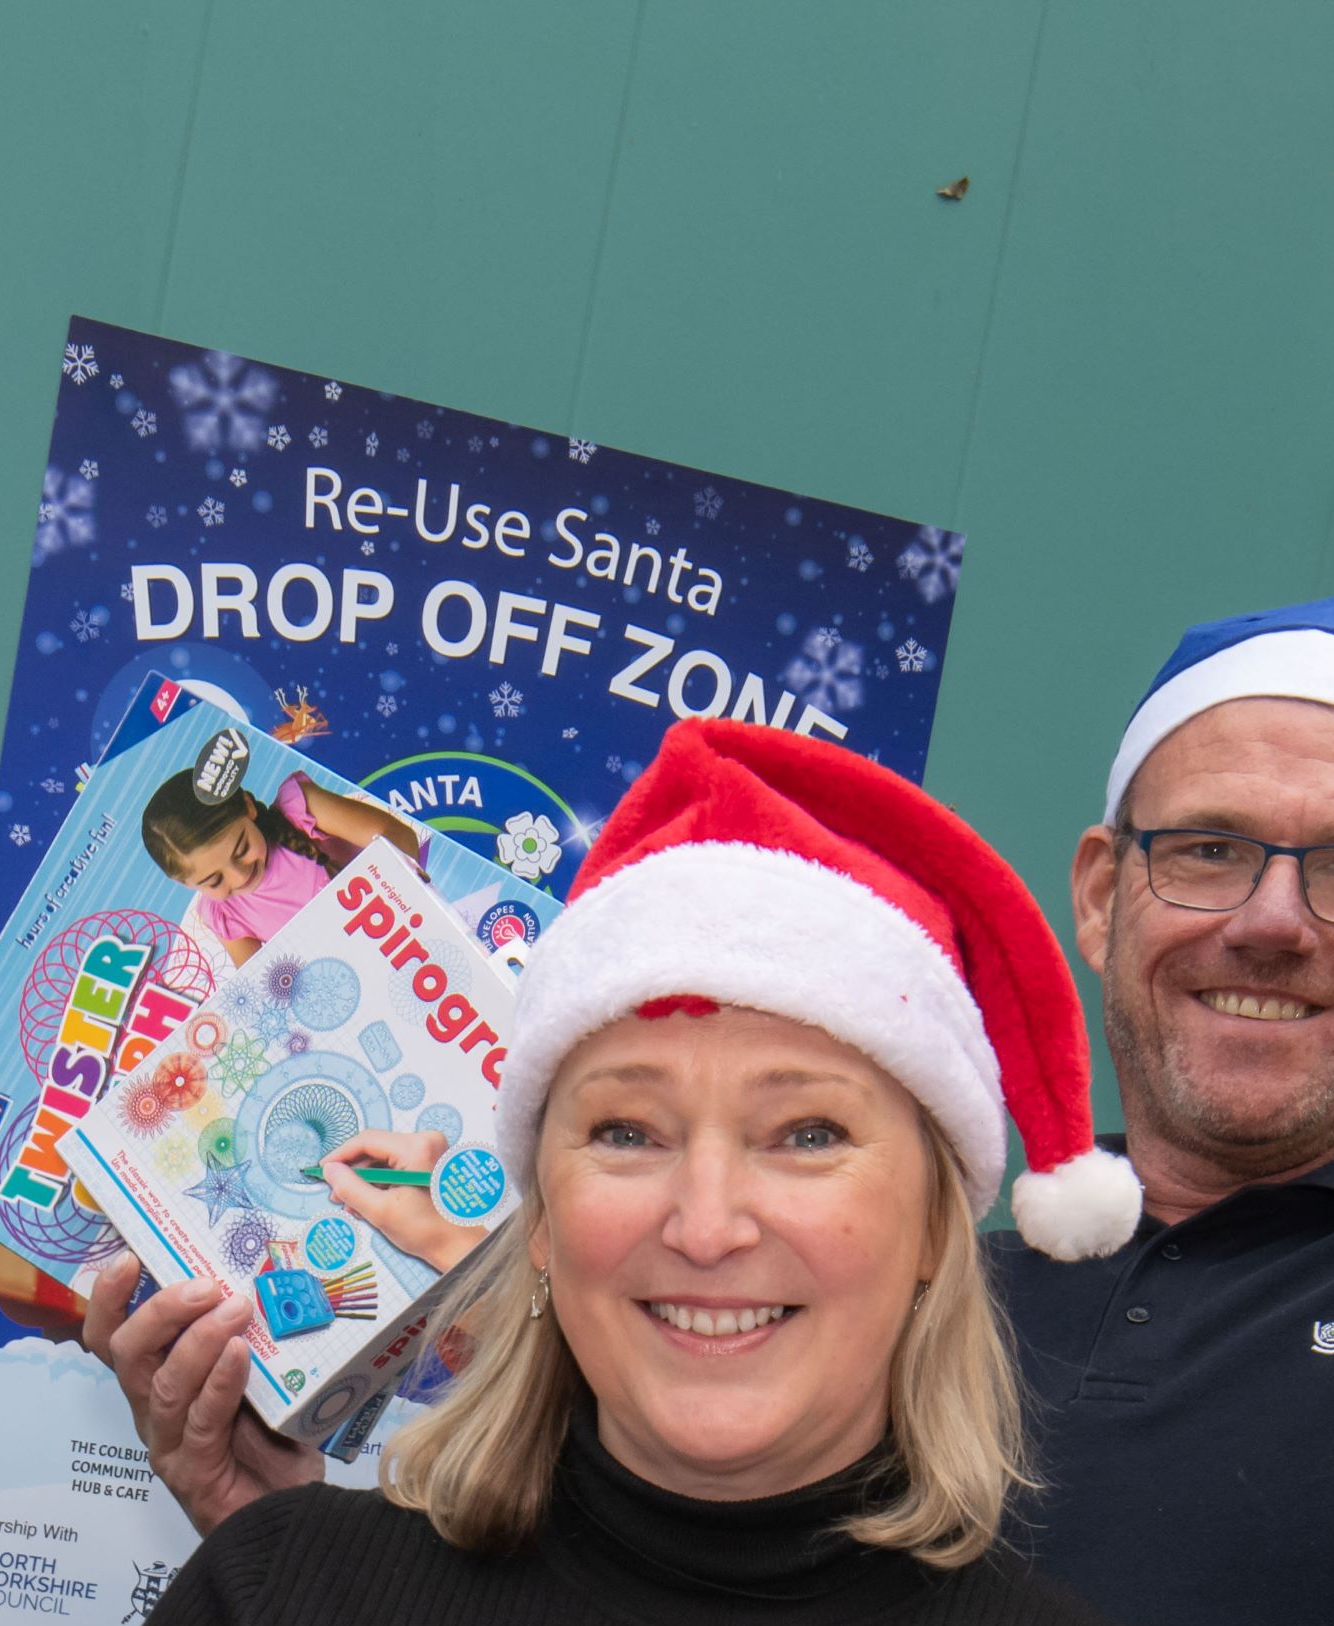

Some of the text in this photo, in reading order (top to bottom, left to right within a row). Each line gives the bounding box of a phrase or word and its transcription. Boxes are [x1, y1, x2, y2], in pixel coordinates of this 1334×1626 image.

[304, 467, 726, 616] Re-Use Santa
[131, 562, 395, 643] DROP
[421, 579, 601, 677] OFF
[157, 691, 169, 711] 4+
[197, 736, 234, 792] NEW!
[389, 775, 483, 813] ANTA
[16, 812, 117, 949] hours of creative fun!
[367, 864, 412, 914] the original
[117, 1150, 217, 1280] The classic way to create countless
[70, 1439, 96, 1455] THE
[71, 1460, 155, 1483] COMMUNITY
[71, 1479, 149, 1502] HUB & CAFE
[43, 1524, 78, 1542] With
